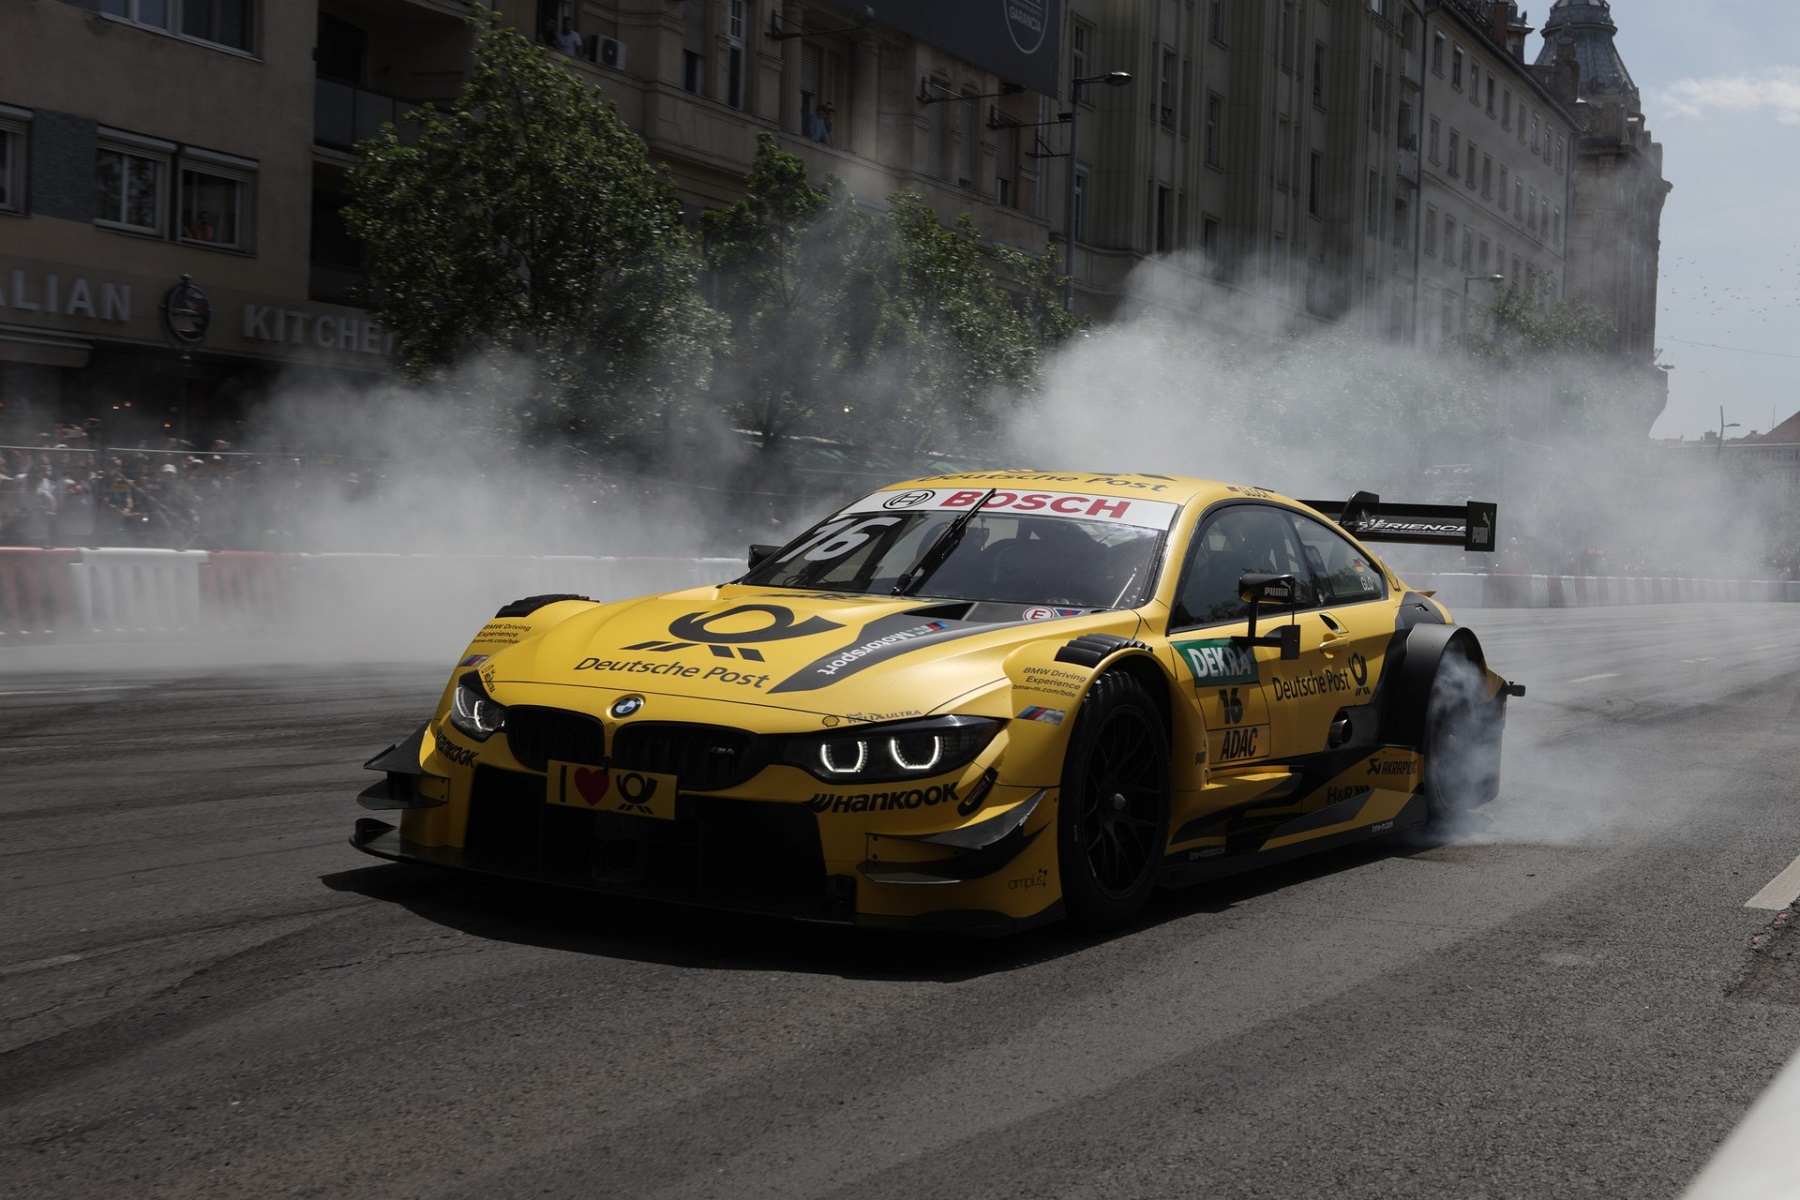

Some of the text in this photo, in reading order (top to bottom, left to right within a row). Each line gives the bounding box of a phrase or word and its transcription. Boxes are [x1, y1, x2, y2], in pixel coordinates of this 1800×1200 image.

[0, 269, 131, 322] LIAN
[1085, 477, 1168, 492] Post
[939, 490, 1132, 518] BOSCH
[774, 516, 902, 564] 16
[816, 630, 917, 675] Motorsport
[1187, 647, 1252, 678] DEKRA
[574, 657, 770, 689] Deutsche Post
[1023, 666, 1087, 683] BMW Driving
[1026, 676, 1081, 690] Experience
[1272, 669, 1351, 701] Deutsche Post
[886, 709, 922, 719] ULTRA
[1219, 687, 1244, 725] 16
[1220, 728, 1258, 760] ADAC
